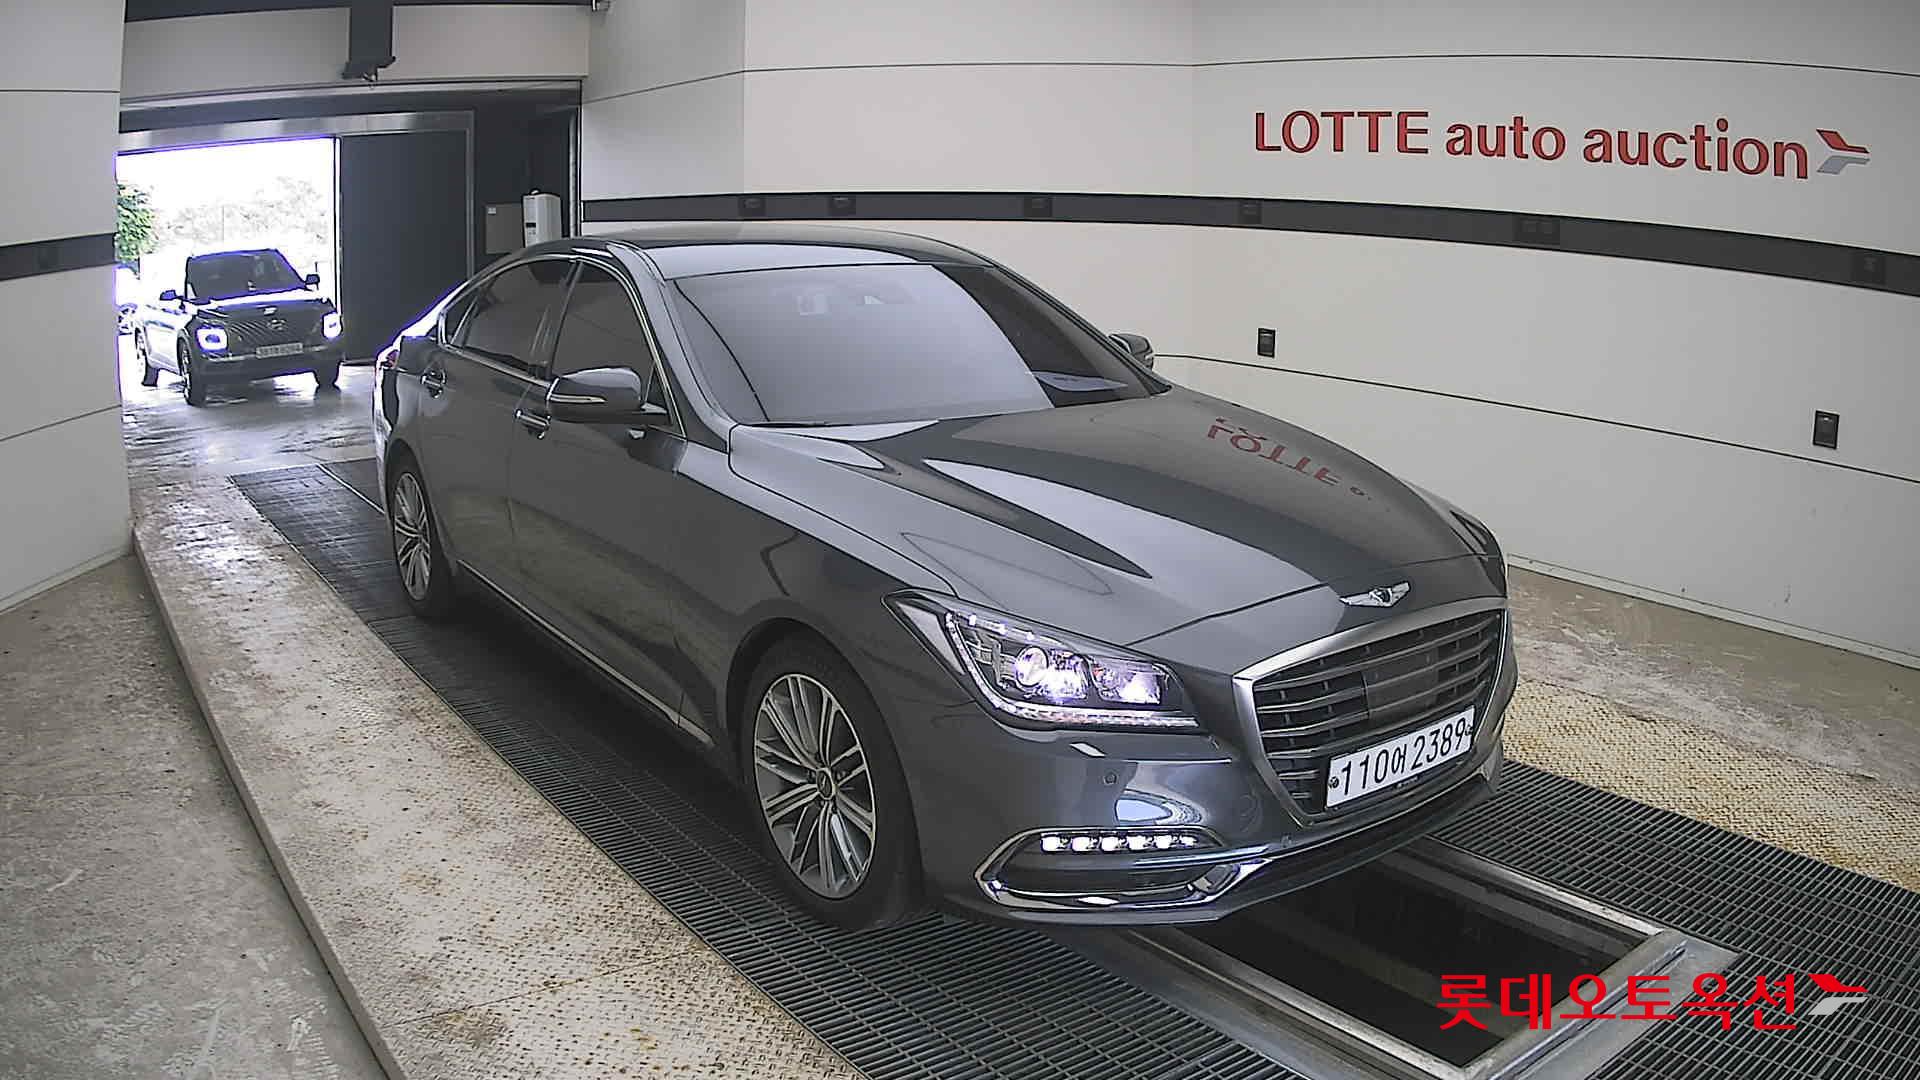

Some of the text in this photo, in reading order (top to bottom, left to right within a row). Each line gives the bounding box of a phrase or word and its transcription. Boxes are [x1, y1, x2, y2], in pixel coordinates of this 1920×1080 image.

[1255, 111, 1810, 179] LOTTE auto auction
[1341, 717, 1466, 796] 110어 2389
